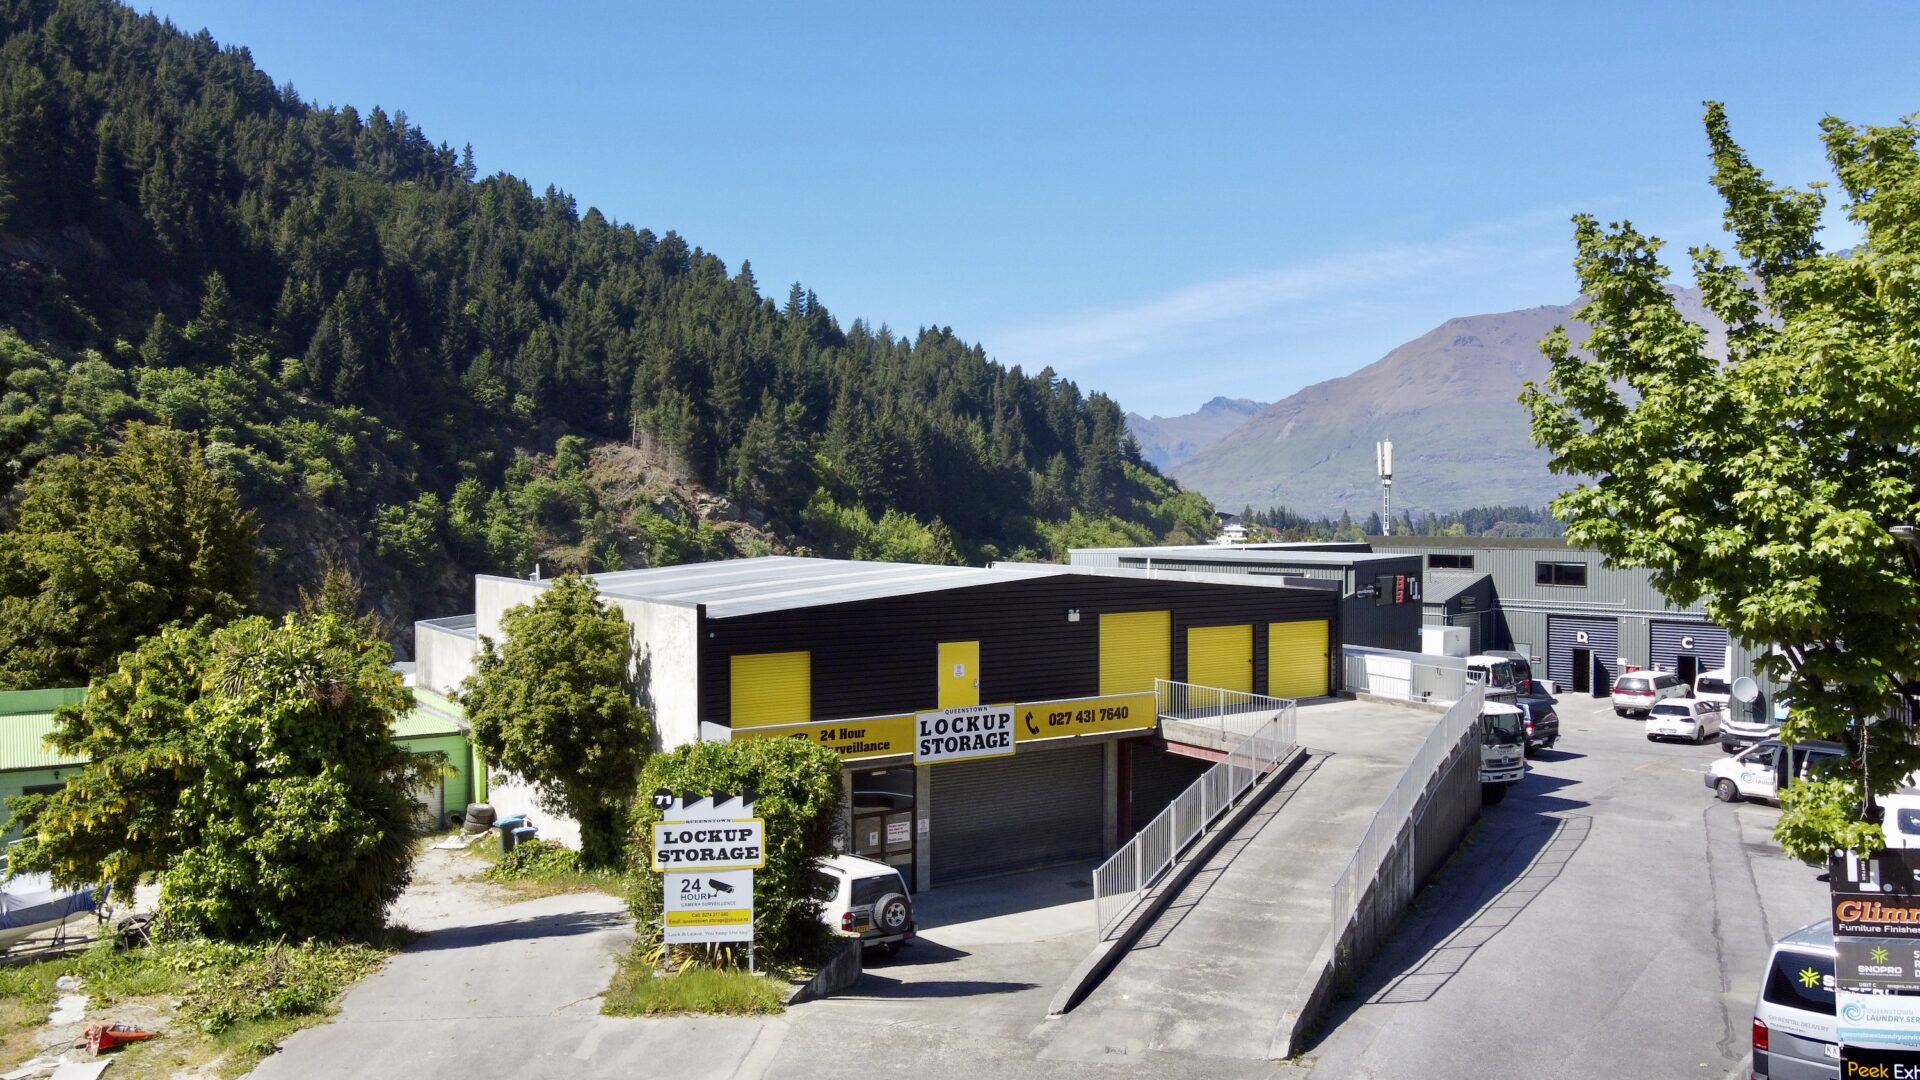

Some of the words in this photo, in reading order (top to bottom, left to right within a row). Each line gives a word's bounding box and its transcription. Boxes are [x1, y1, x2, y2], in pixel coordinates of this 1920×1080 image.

[1576, 631, 1589, 643] D
[1681, 637, 1694, 648] C
[944, 706, 988, 715] QUEENSTOWN
[1048, 711, 1072, 726] 027
[1075, 709, 1096, 723] 431
[1099, 706, 1129, 721] 7640
[920, 713, 1010, 737] LOCKUP
[820, 729, 836, 741] 24
[839, 728, 866, 740] Hour
[920, 731, 1010, 756] STORAGE
[654, 794, 672, 805] 71
[663, 828, 753, 844] LOCKUP
[657, 846, 759, 863] STORAGE
[680, 878, 701, 893] 24
[680, 893, 707, 901] HOUR
[1838, 923, 1882, 933] Furniture
[1857, 965, 1903, 974] SNOPRO
[1777, 1016, 1800, 1027] RENTAL
[1866, 1014, 1905, 1023] LAUNDRY
[1847, 1061, 1889, 1079] Peek
